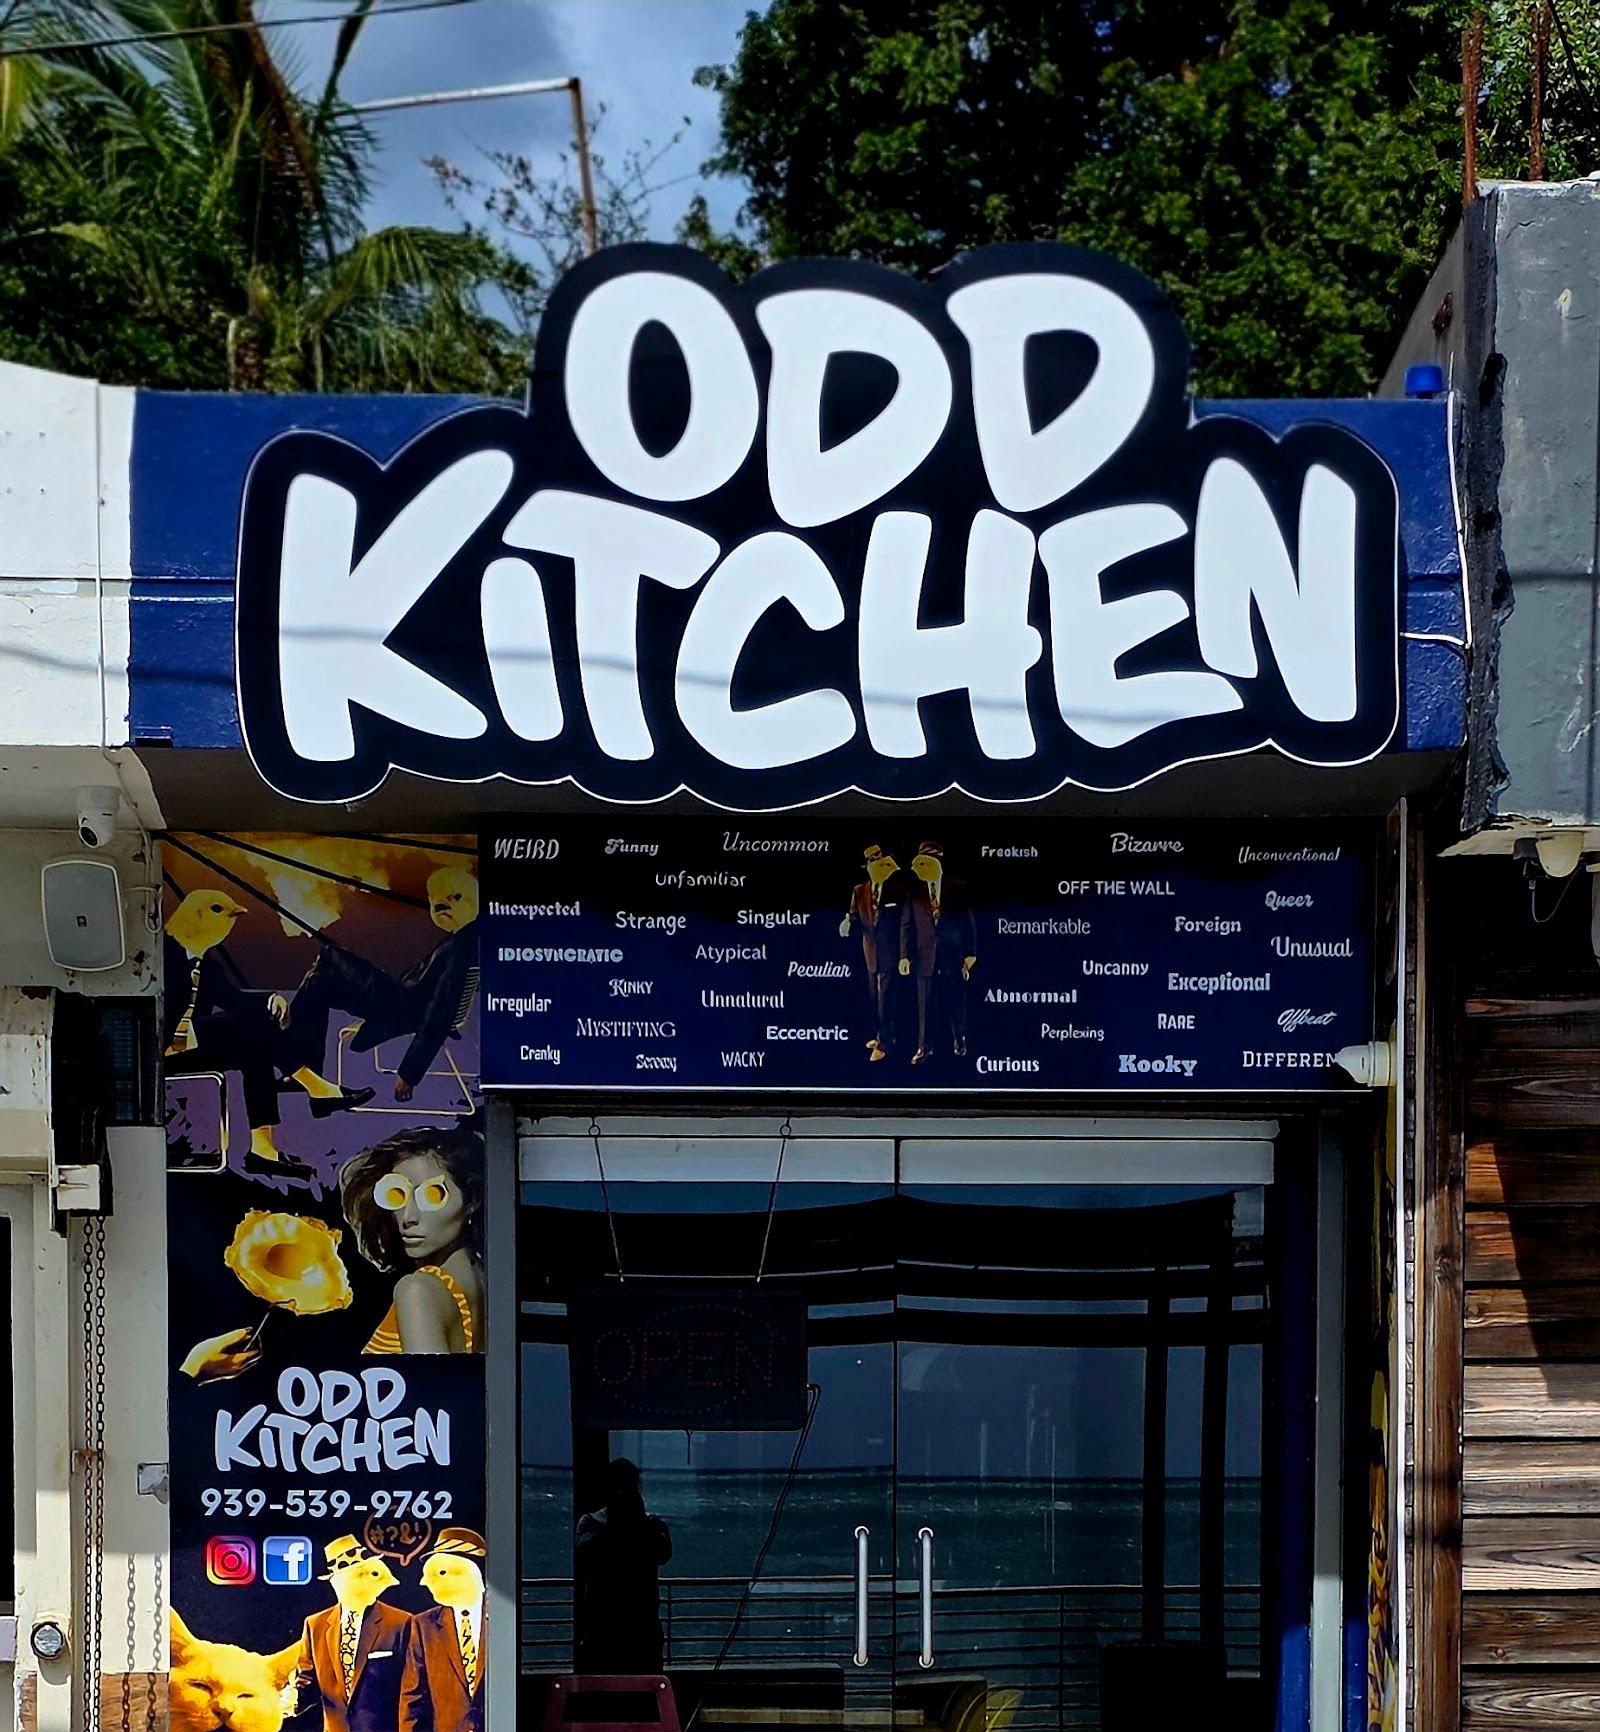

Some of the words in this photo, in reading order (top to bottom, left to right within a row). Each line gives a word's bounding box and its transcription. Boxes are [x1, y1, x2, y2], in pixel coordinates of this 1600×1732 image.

[565, 271, 1155, 528] ODD
[278, 449, 1358, 770] KITCHEN
[494, 838, 560, 860] WEIRD
[604, 838, 659, 857] Funny
[722, 831, 829, 852] Uncommon
[981, 845, 1039, 858] Freakish
[1109, 832, 1185, 854] Bizarre
[1238, 845, 1341, 864] Unconventional
[1057, 880, 1090, 895] OFF
[1094, 880, 1126, 896] THE
[1129, 880, 1176, 896] WALL
[488, 900, 581, 921] Unexpected
[1264, 890, 1314, 912] Queer
[615, 910, 687, 936] Strange
[737, 909, 811, 929] Singular
[997, 917, 1091, 935] Remarkable
[1174, 915, 1242, 936] Foreign
[498, 947, 624, 964] IDIOSYNCRATIC
[695, 943, 767, 964] Atypical
[1270, 935, 1354, 958] Unusual
[787, 960, 852, 978] Peculiar
[1082, 959, 1149, 976] Uncanny
[1167, 971, 1271, 996] Exceptional
[487, 992, 552, 1018] Irregular
[701, 989, 785, 1009] Unnatural
[984, 988, 1078, 1004] Abnormal
[1277, 1008, 1337, 1033] Offbeat
[766, 1025, 849, 1041] Eccentric
[1041, 1022, 1105, 1042] Perplexing
[520, 1044, 561, 1065] Cranky
[720, 1050, 766, 1068] WACKY
[976, 1055, 1040, 1074] Curious
[1242, 1050, 1339, 1068] DIFFEREN
[1118, 1054, 1198, 1077] Kooky
[594, 1330, 774, 1387] OPEN
[277, 1366, 406, 1422] ODD
[215, 1404, 450, 1474] KITCHEN
[201, 1488, 453, 1519] 939-539-9762
